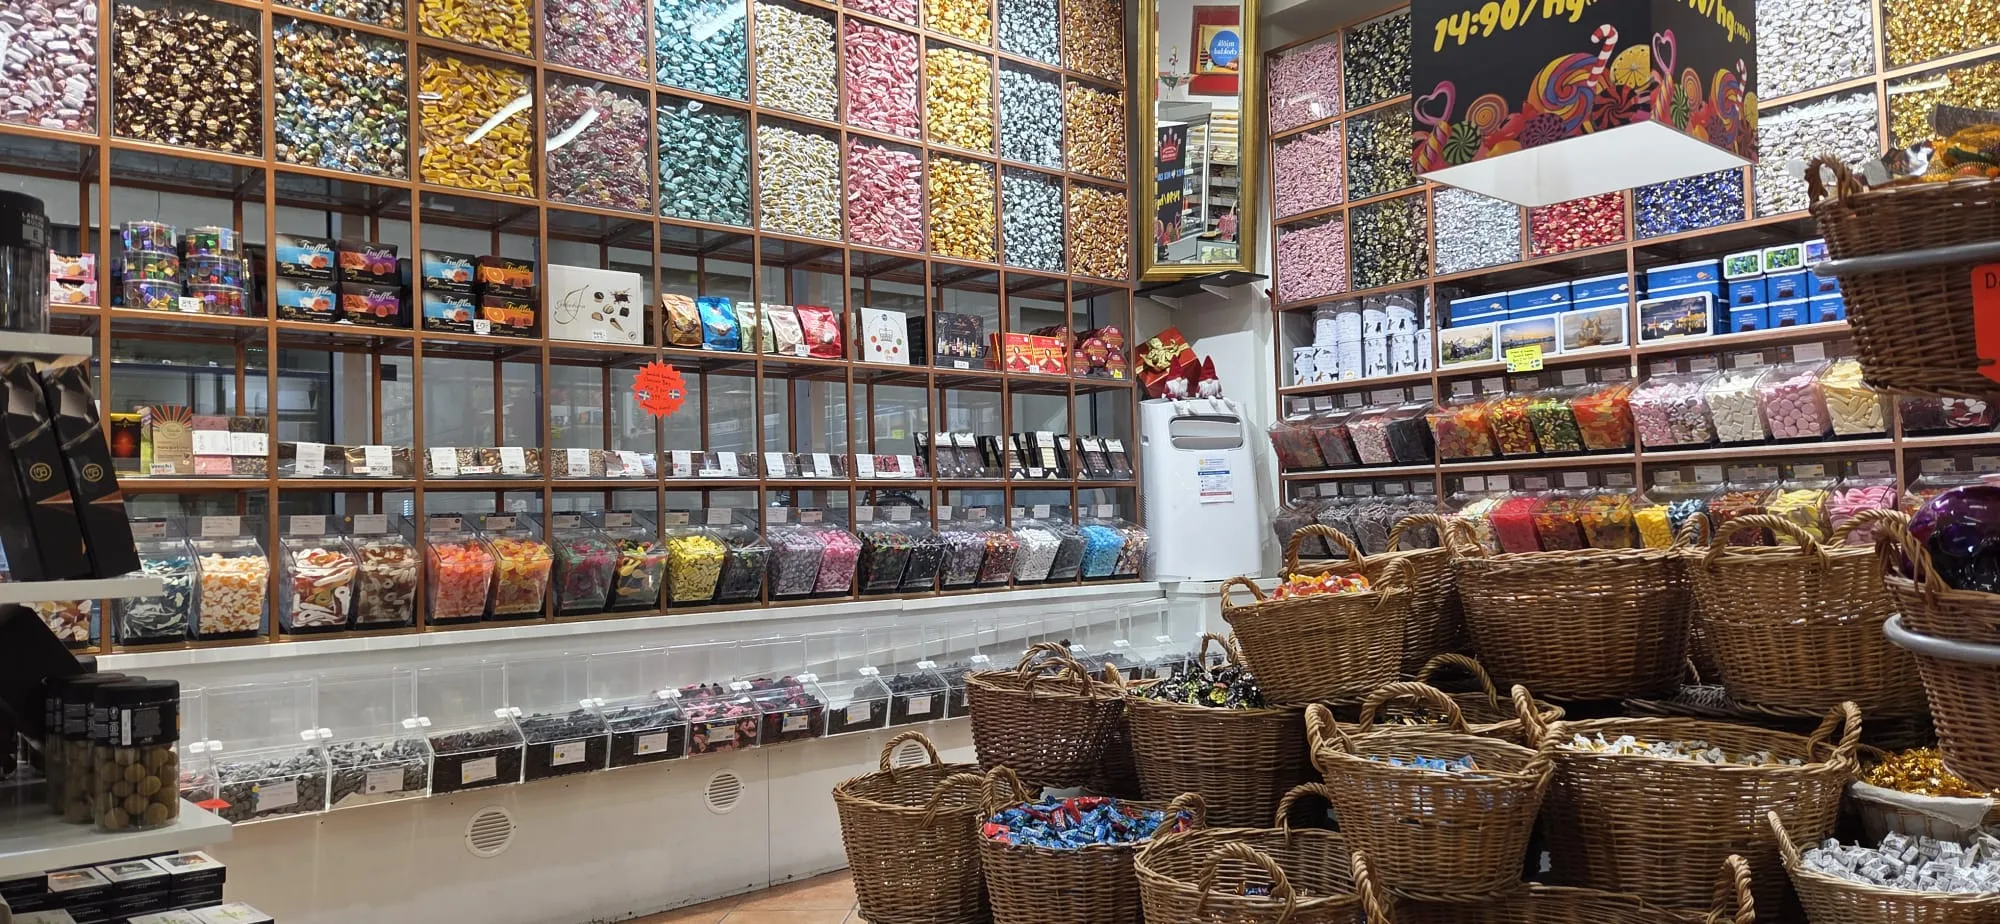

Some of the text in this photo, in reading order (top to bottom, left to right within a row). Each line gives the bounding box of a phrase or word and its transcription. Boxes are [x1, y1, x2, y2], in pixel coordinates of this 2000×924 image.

[300, 239, 330, 254] Truffles
[364, 246, 393, 260] Truffles
[444, 255, 471, 269] Truffles
[1984, 271, 2000, 289] D
[301, 283, 332, 298] Truffles
[367, 288, 396, 302] Truffles
[444, 295, 472, 309] Truffles
